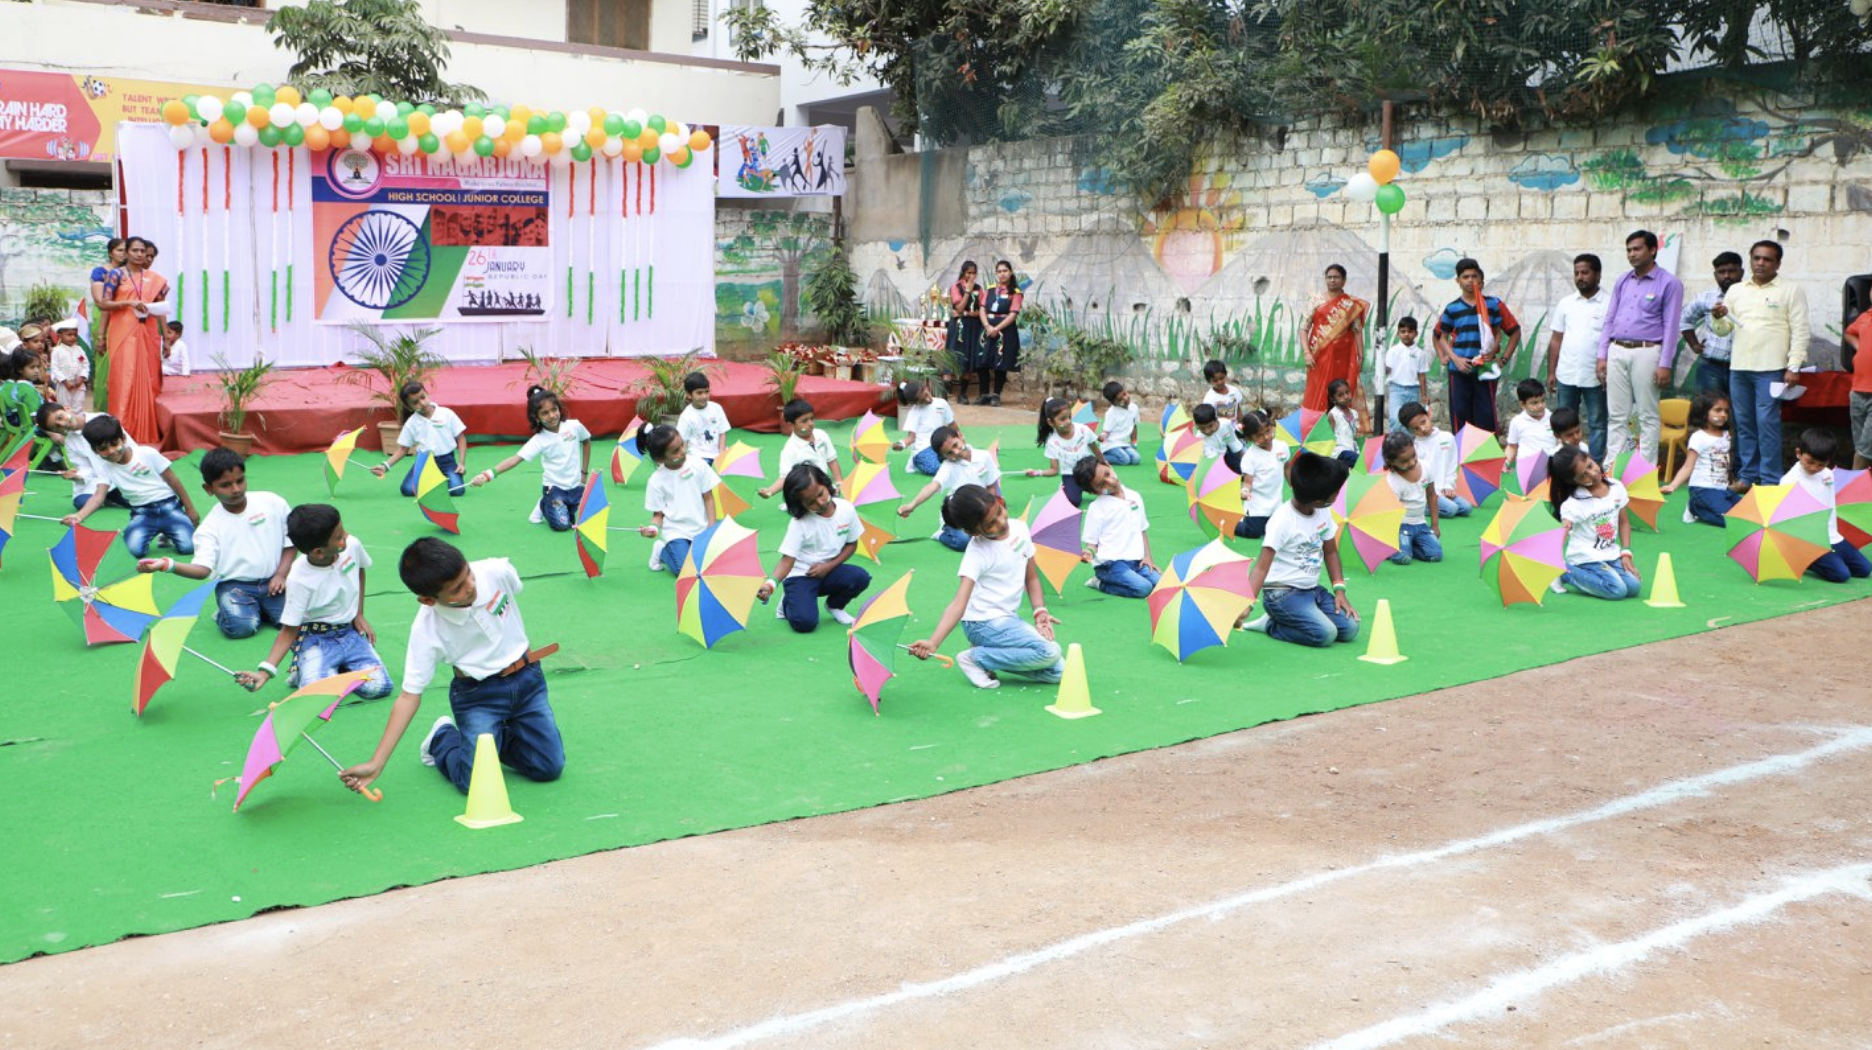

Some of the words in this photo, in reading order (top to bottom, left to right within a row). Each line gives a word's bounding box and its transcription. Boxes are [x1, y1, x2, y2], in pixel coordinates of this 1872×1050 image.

[123, 93, 152, 104] TALENT
[29, 101, 67, 117] HARD
[122, 105, 136, 113] BUT
[15, 116, 67, 133] HARDER
[385, 152, 421, 175] SRI
[388, 192, 413, 201] HIGH
[416, 192, 456, 203] SCHOOL
[463, 193, 499, 203] JUNIOR
[501, 194, 544, 204] COLLEGE
[468, 250, 486, 266] 26
[483, 260, 525, 274] JANUARY
